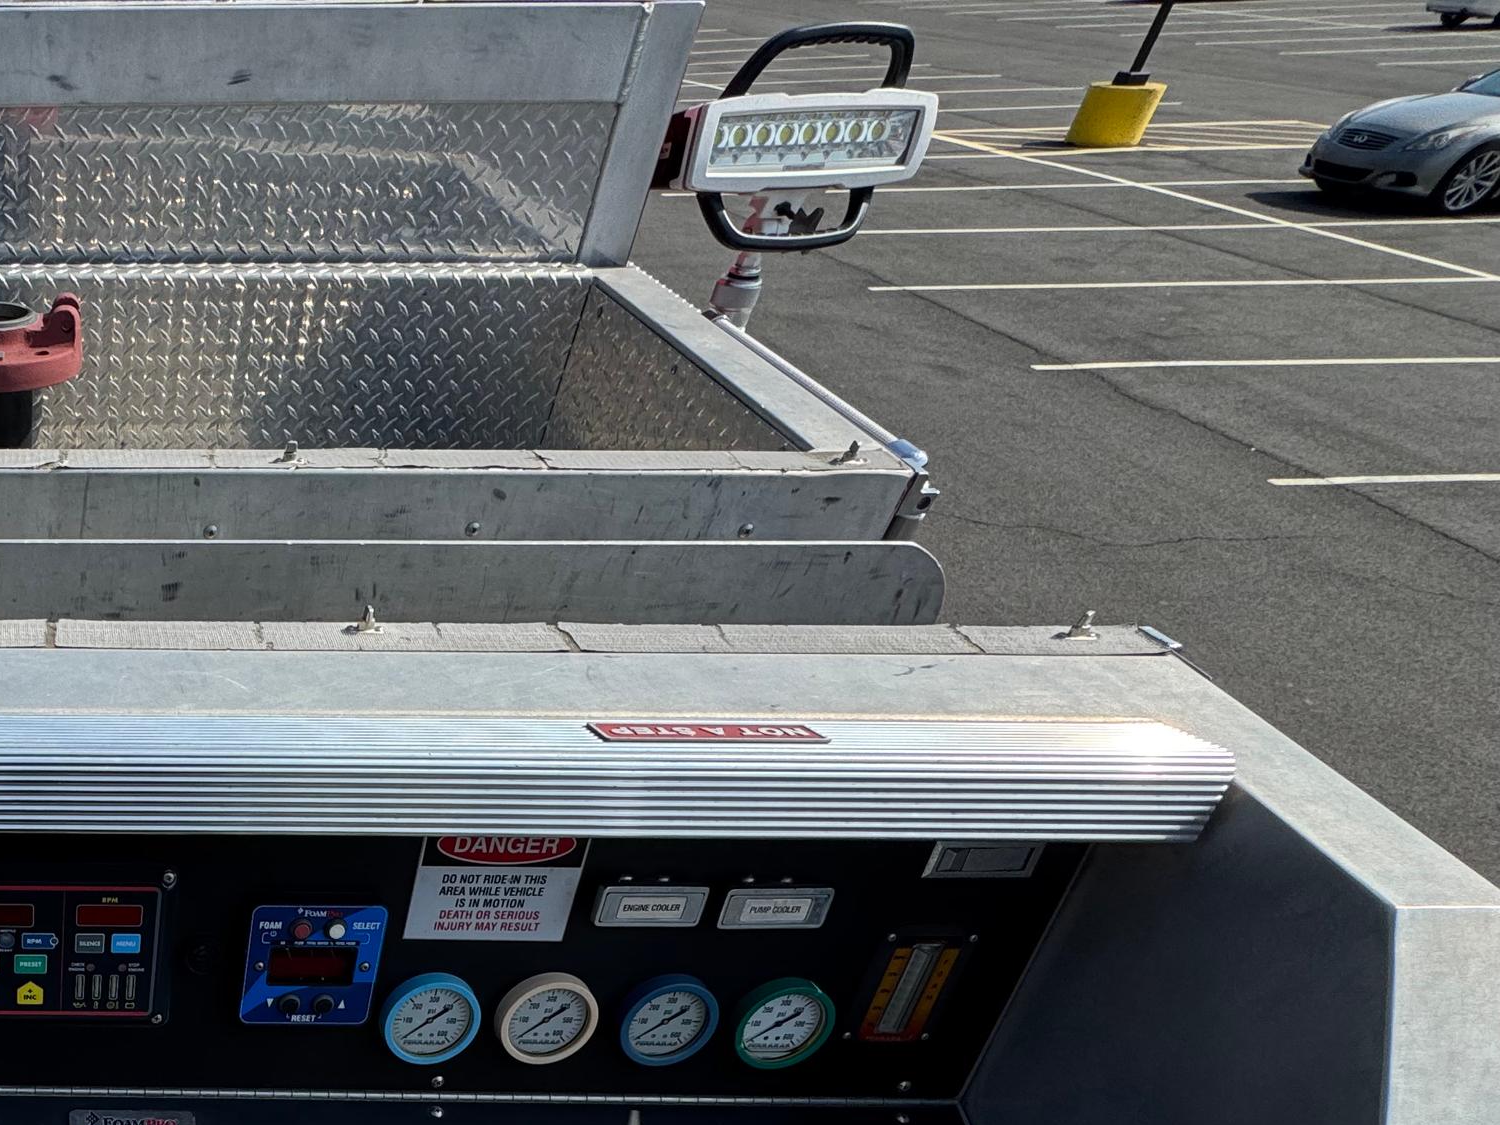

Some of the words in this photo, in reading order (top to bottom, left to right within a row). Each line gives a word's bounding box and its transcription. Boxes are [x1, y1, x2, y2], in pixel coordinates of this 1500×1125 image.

[611, 727, 696, 736] STEP
[699, 727, 725, 736] A
[738, 727, 810, 736] NOT
[454, 837, 559, 854] DANGER
[442, 874, 456, 885] DO
[460, 874, 481, 885] NOT
[483, 874, 508, 885] RIDE
[509, 874, 521, 885] IN
[524, 874, 547, 885] THIS
[439, 886, 465, 897] AREA
[469, 886, 500, 897] WHILE
[503, 886, 545, 897] VEHICLE
[455, 898, 465, 908] IS
[469, 898, 479, 908] IN
[483, 898, 525, 908] MOTION
[622, 904, 649, 912] ENGINE
[651, 904, 681, 912] COOLER
[749, 906, 771, 914] PUMP
[772, 906, 801, 914] COOLER
[439, 910, 473, 920] DEATH
[476, 910, 488, 920] OR
[494, 910, 540, 920] SERIOUS
[259, 921, 283, 930] FOAM
[352, 922, 381, 930] SELECT
[434, 922, 471, 932] INJURY
[475, 922, 497, 932] MAY
[500, 922, 541, 932] RESULT
[291, 1014, 316, 1022] RESET
